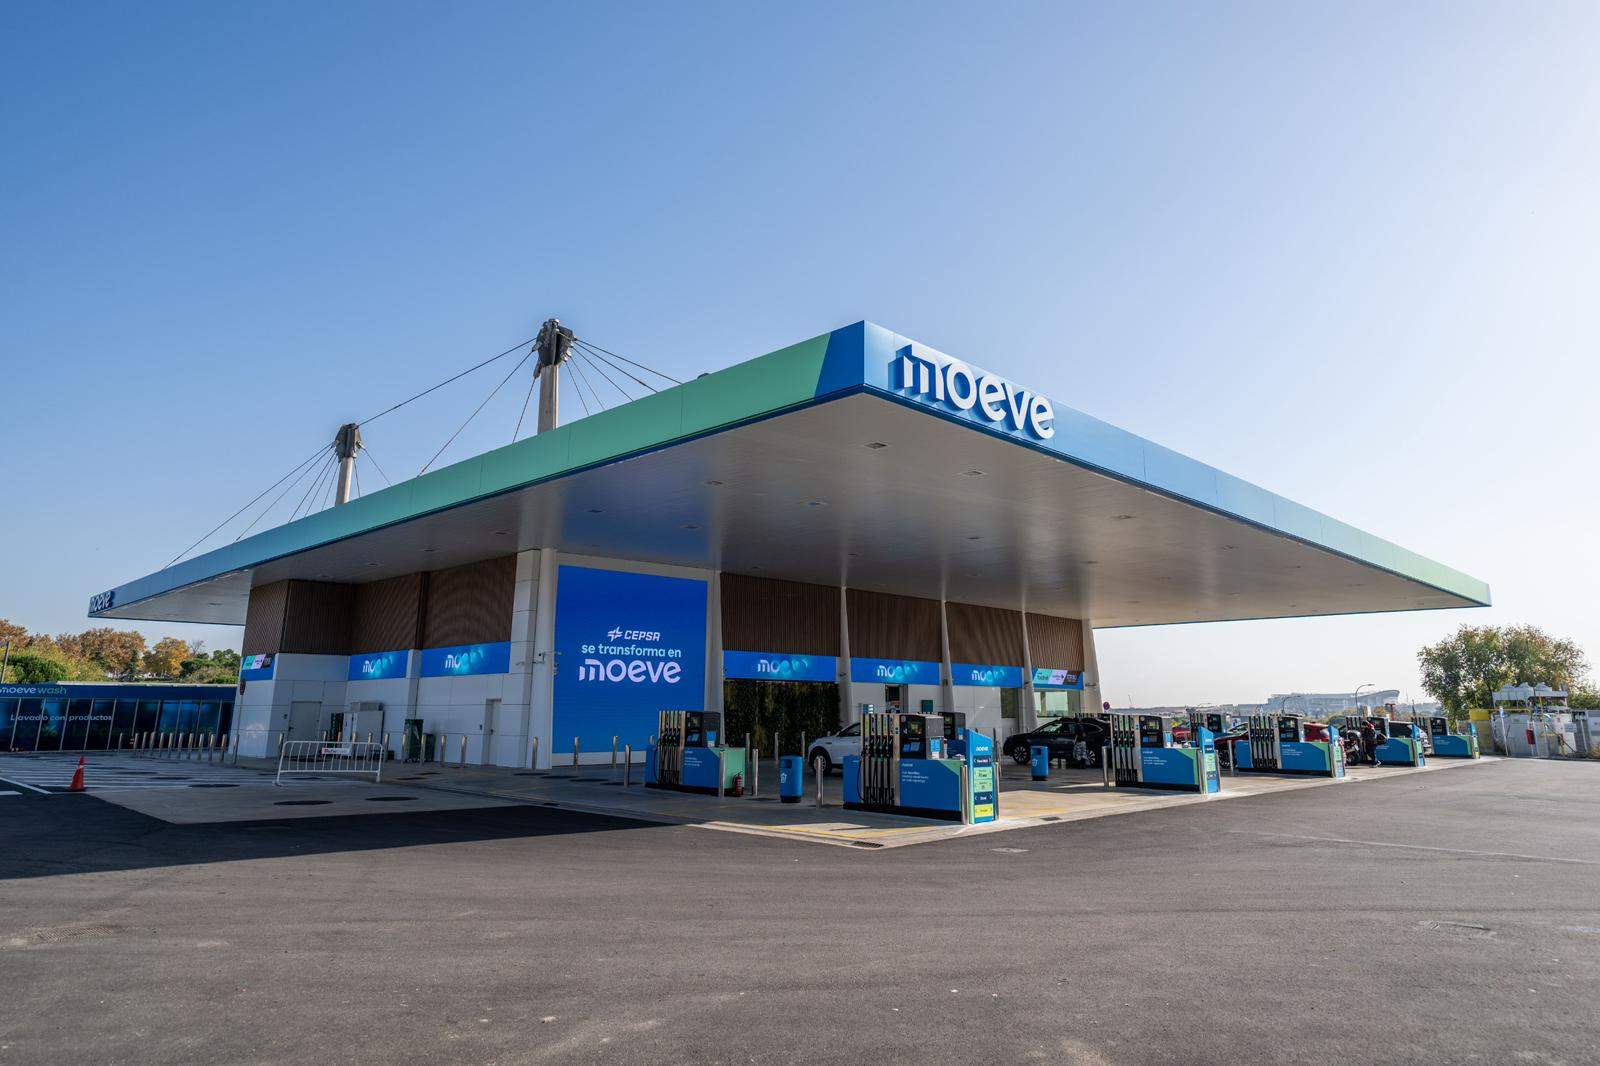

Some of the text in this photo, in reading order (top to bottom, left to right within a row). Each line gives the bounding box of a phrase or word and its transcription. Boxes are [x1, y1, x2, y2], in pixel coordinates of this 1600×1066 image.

[902, 345, 1055, 439] moeve
[624, 630, 660, 641] CEPSA
[581, 643, 682, 658] se transforma en
[578, 658, 682, 684] moeve
[37, 686, 67, 695] wash
